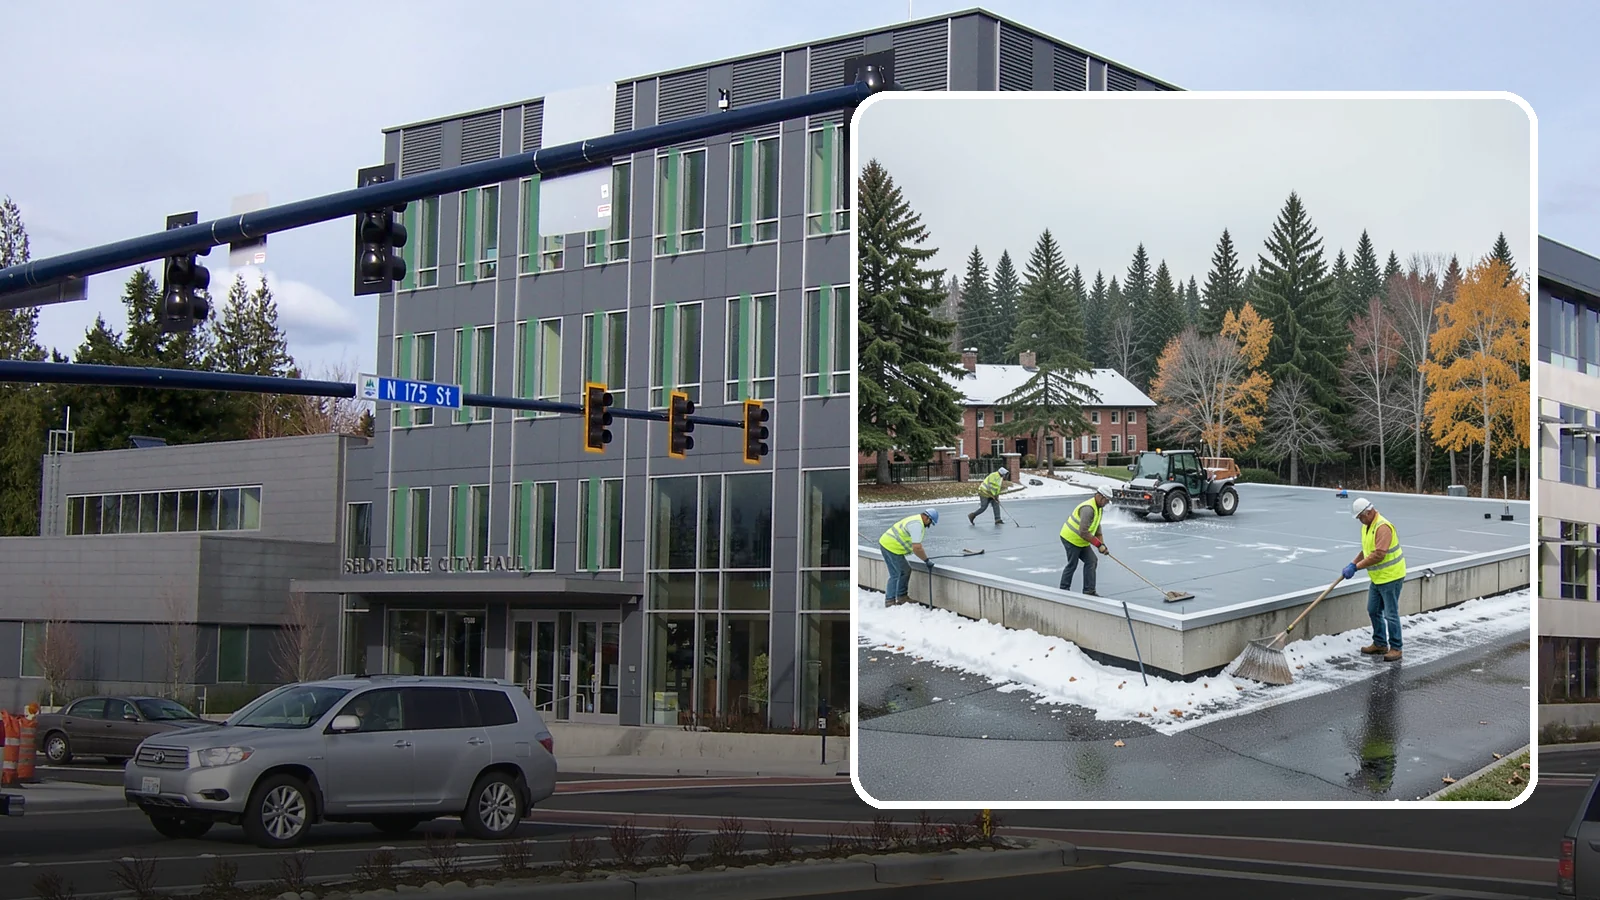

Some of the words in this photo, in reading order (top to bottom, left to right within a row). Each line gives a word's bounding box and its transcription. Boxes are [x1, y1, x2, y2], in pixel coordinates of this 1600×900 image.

[387, 380, 396, 399] N
[405, 382, 427, 403] 175
[436, 386, 451, 406] St
[344, 557, 432, 574] SHORELINE
[438, 556, 476, 572] CITY
[484, 556, 525, 572] HALL
